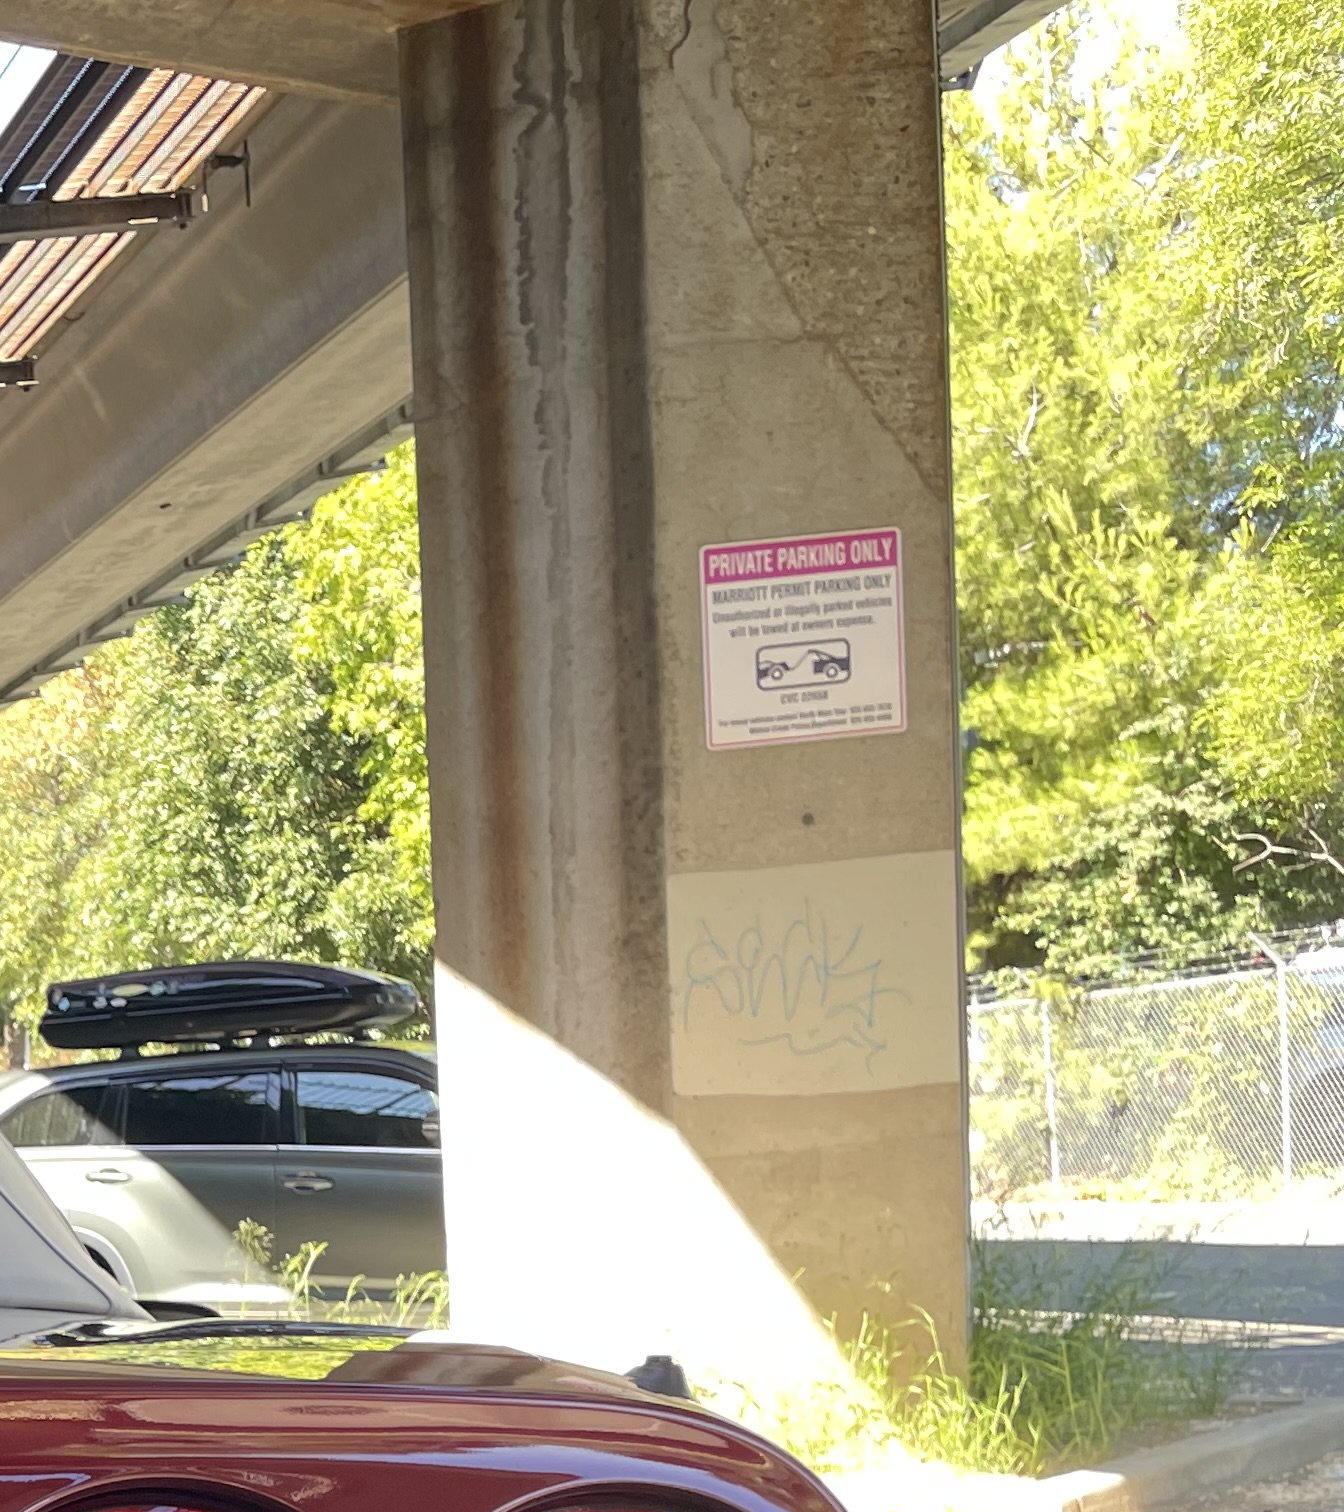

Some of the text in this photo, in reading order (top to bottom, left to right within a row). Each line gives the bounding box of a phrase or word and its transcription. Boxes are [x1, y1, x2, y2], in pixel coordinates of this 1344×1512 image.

[709, 537, 893, 577] PRIVATE PARKING ONLY
[712, 573, 892, 605] MARRIOTT PERMIT PARKING ONLY
[823, 599, 853, 615] parked
[748, 624, 759, 637] be
[761, 621, 788, 635] towed
